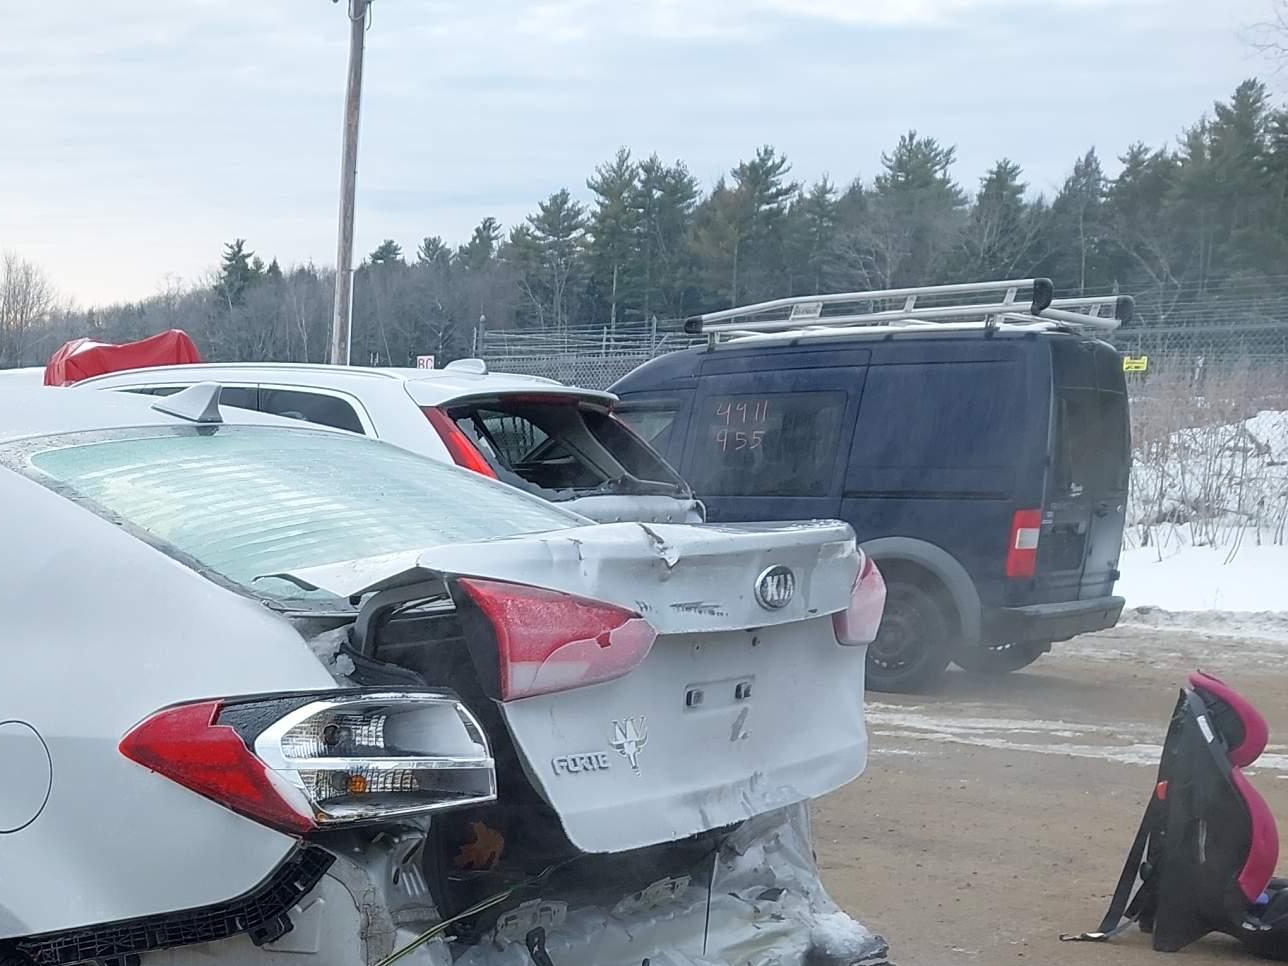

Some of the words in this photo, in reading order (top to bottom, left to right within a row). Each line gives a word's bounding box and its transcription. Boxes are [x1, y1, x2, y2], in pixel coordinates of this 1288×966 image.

[716, 429, 766, 452] 955
[765, 573, 793, 601] KIA
[551, 752, 609, 776] FORTE
